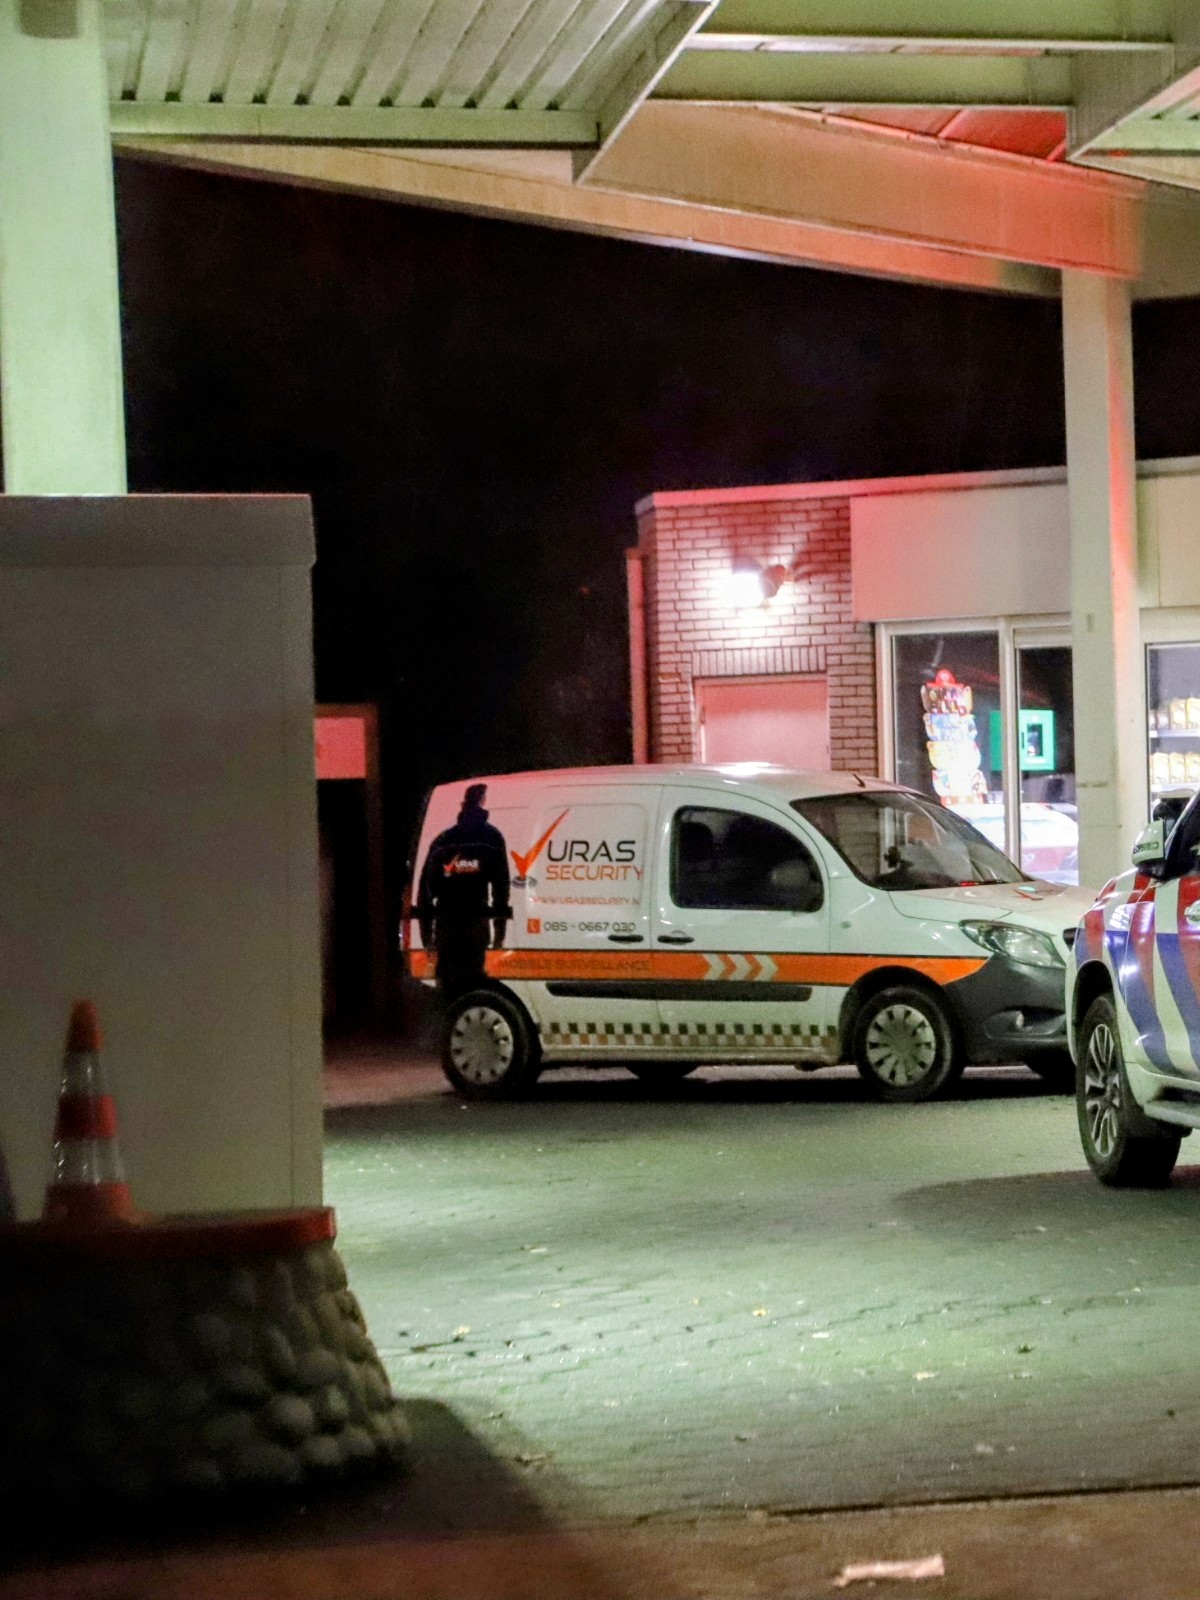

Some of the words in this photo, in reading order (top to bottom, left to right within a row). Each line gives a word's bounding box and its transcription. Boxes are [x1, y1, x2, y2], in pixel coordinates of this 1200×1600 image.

[547, 839, 636, 862] URAS
[545, 864, 643, 882] SECURITY
[544, 921, 569, 932] 085
[578, 921, 610, 932] 0667
[612, 922, 636, 933] 030
